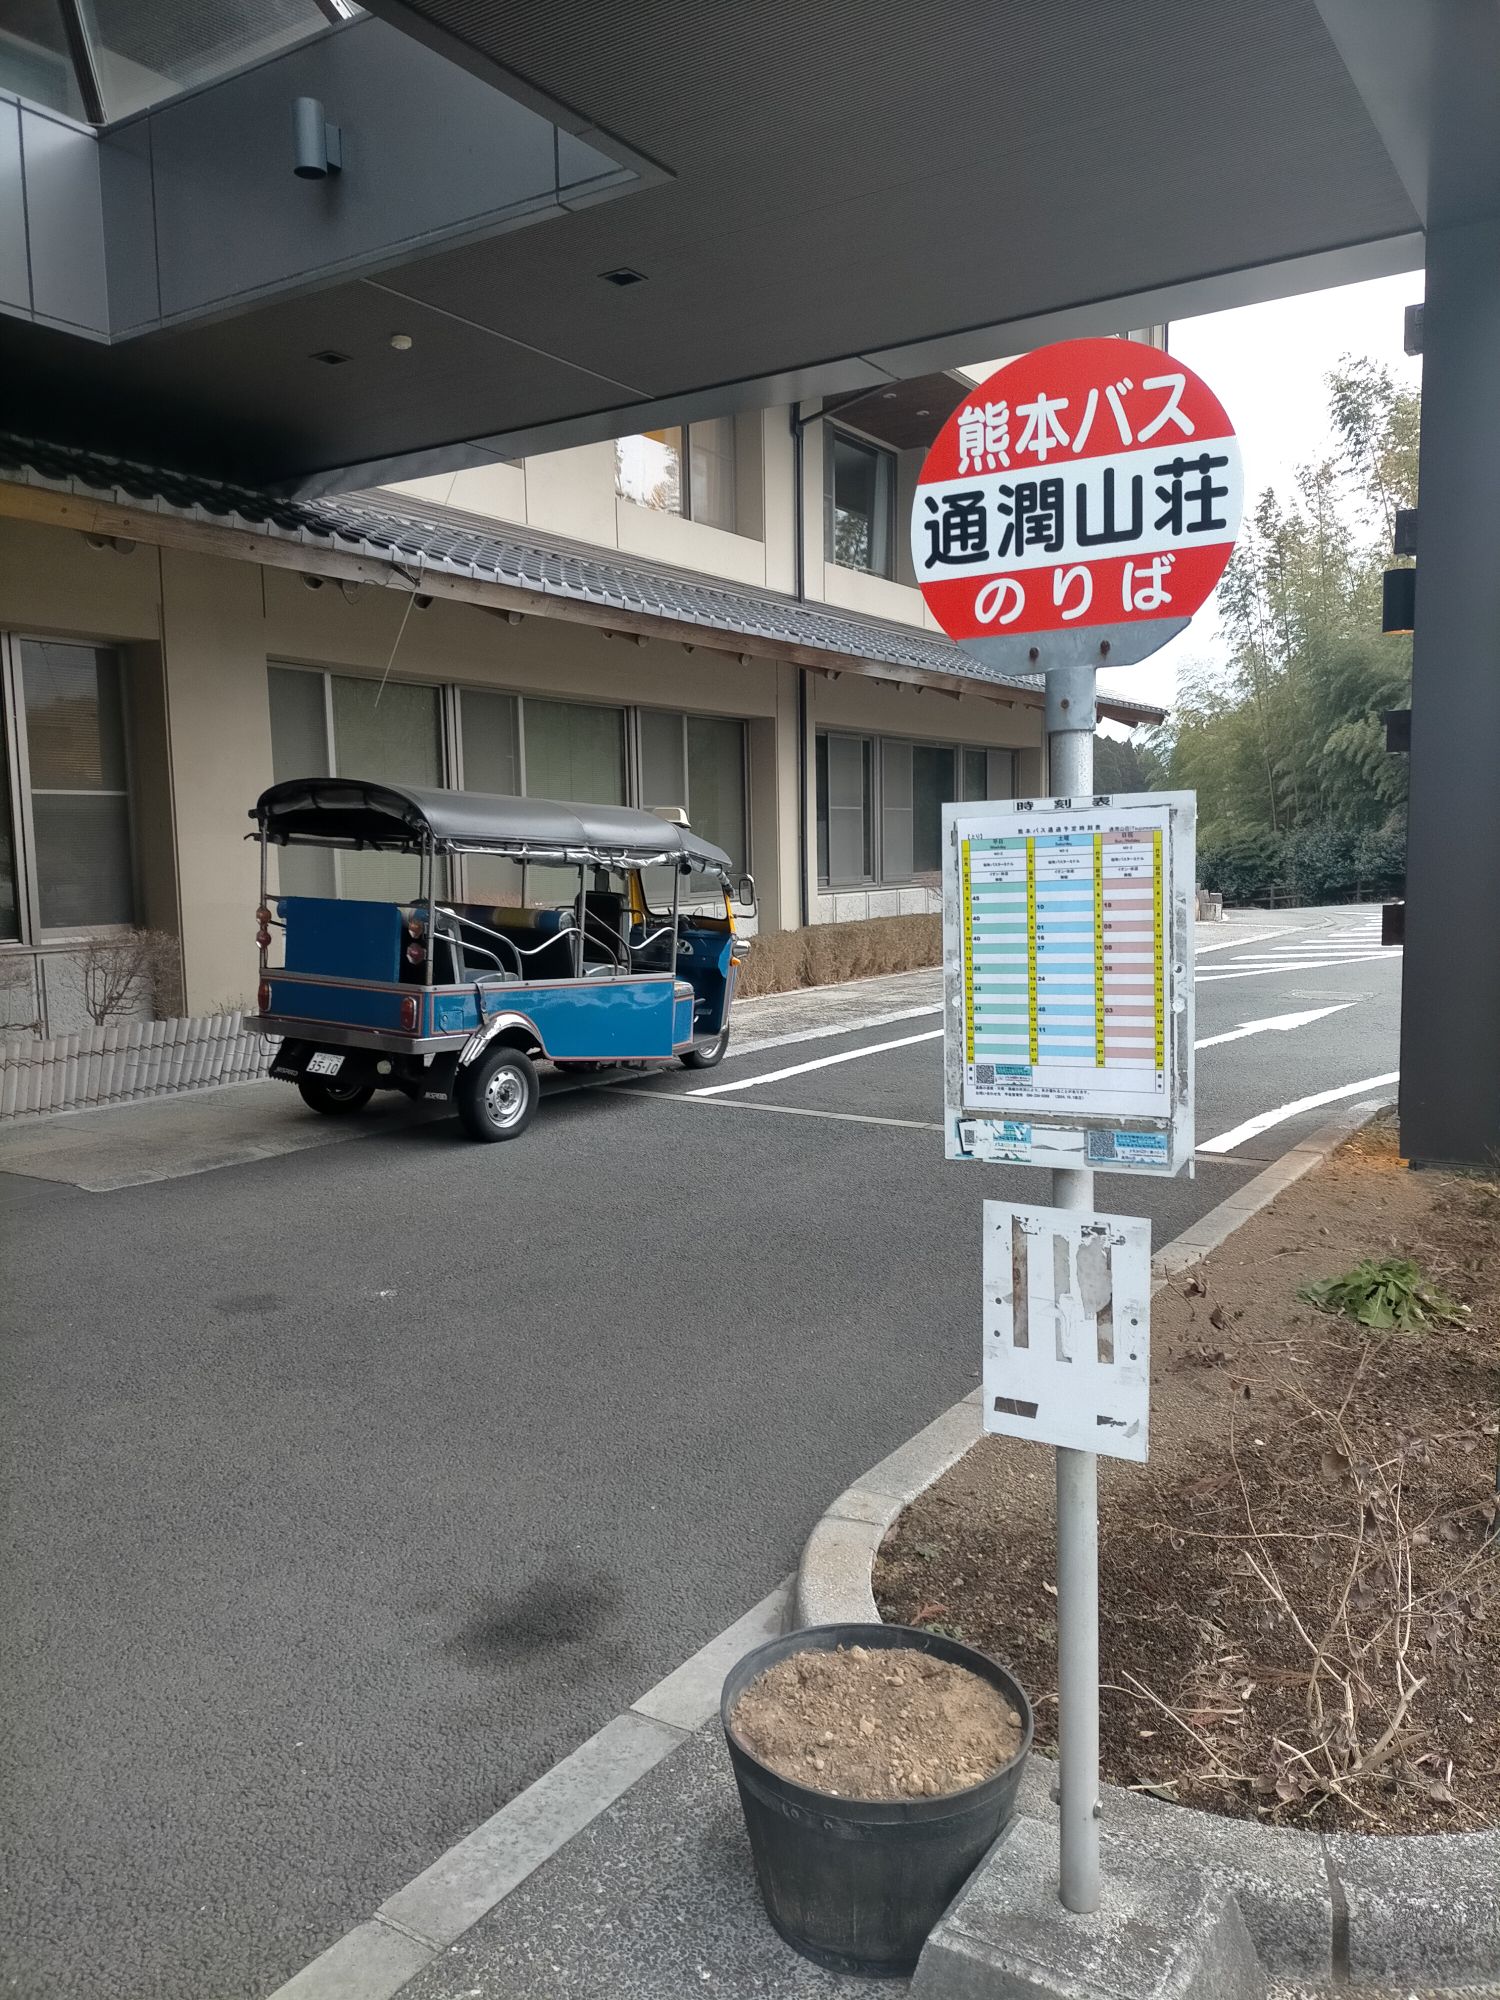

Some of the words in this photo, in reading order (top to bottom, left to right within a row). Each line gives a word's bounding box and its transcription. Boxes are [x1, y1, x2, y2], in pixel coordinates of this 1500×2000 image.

[957, 373, 1195, 474] 熊本バス
[924, 453, 1229, 569] 通潤山荘
[974, 553, 1175, 625] のりば
[1016, 797, 1110, 810] 時刻表
